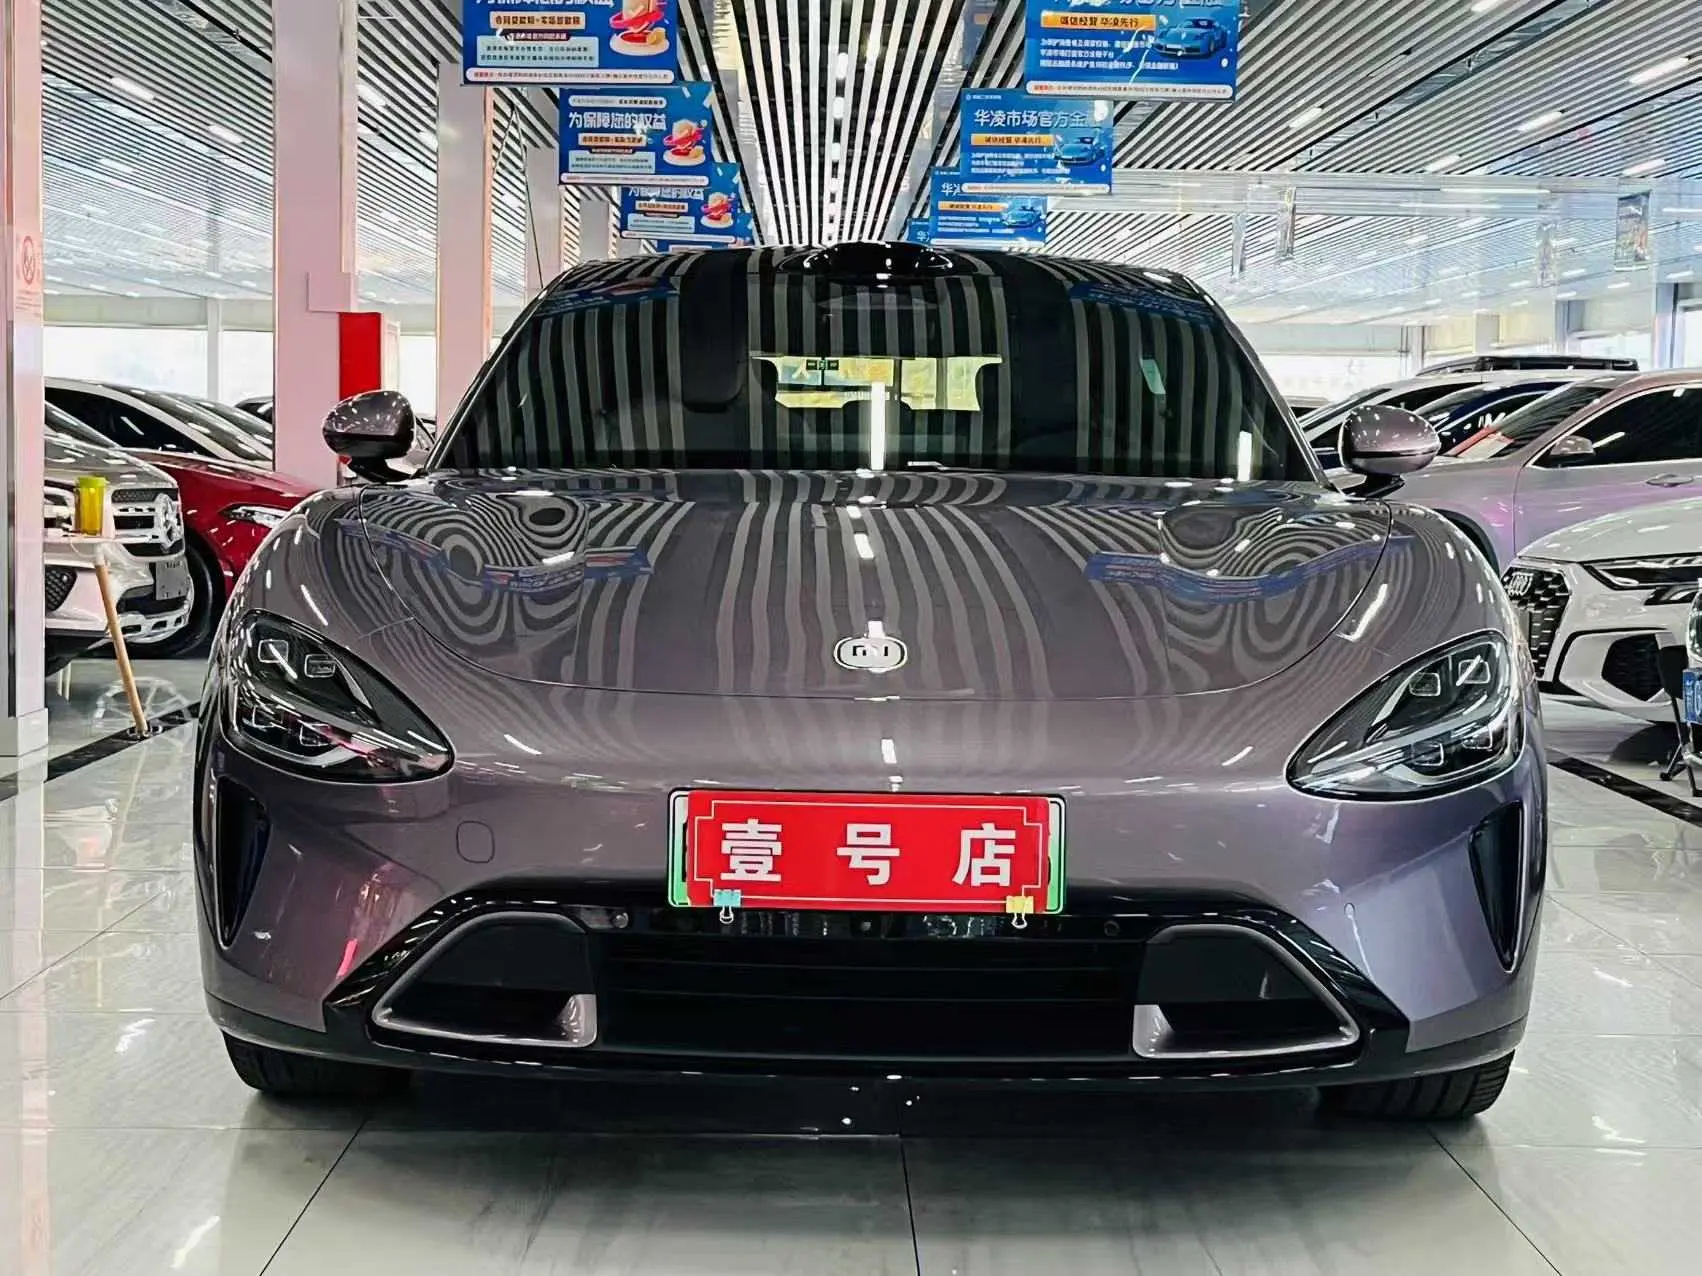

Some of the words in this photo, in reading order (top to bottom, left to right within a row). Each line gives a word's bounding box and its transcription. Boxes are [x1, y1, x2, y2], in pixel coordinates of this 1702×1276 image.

[568, 112, 667, 130] 为保障您的权益
[974, 109, 1092, 129] 华凌市场官方金
[720, 819, 1017, 887] 壹号店
